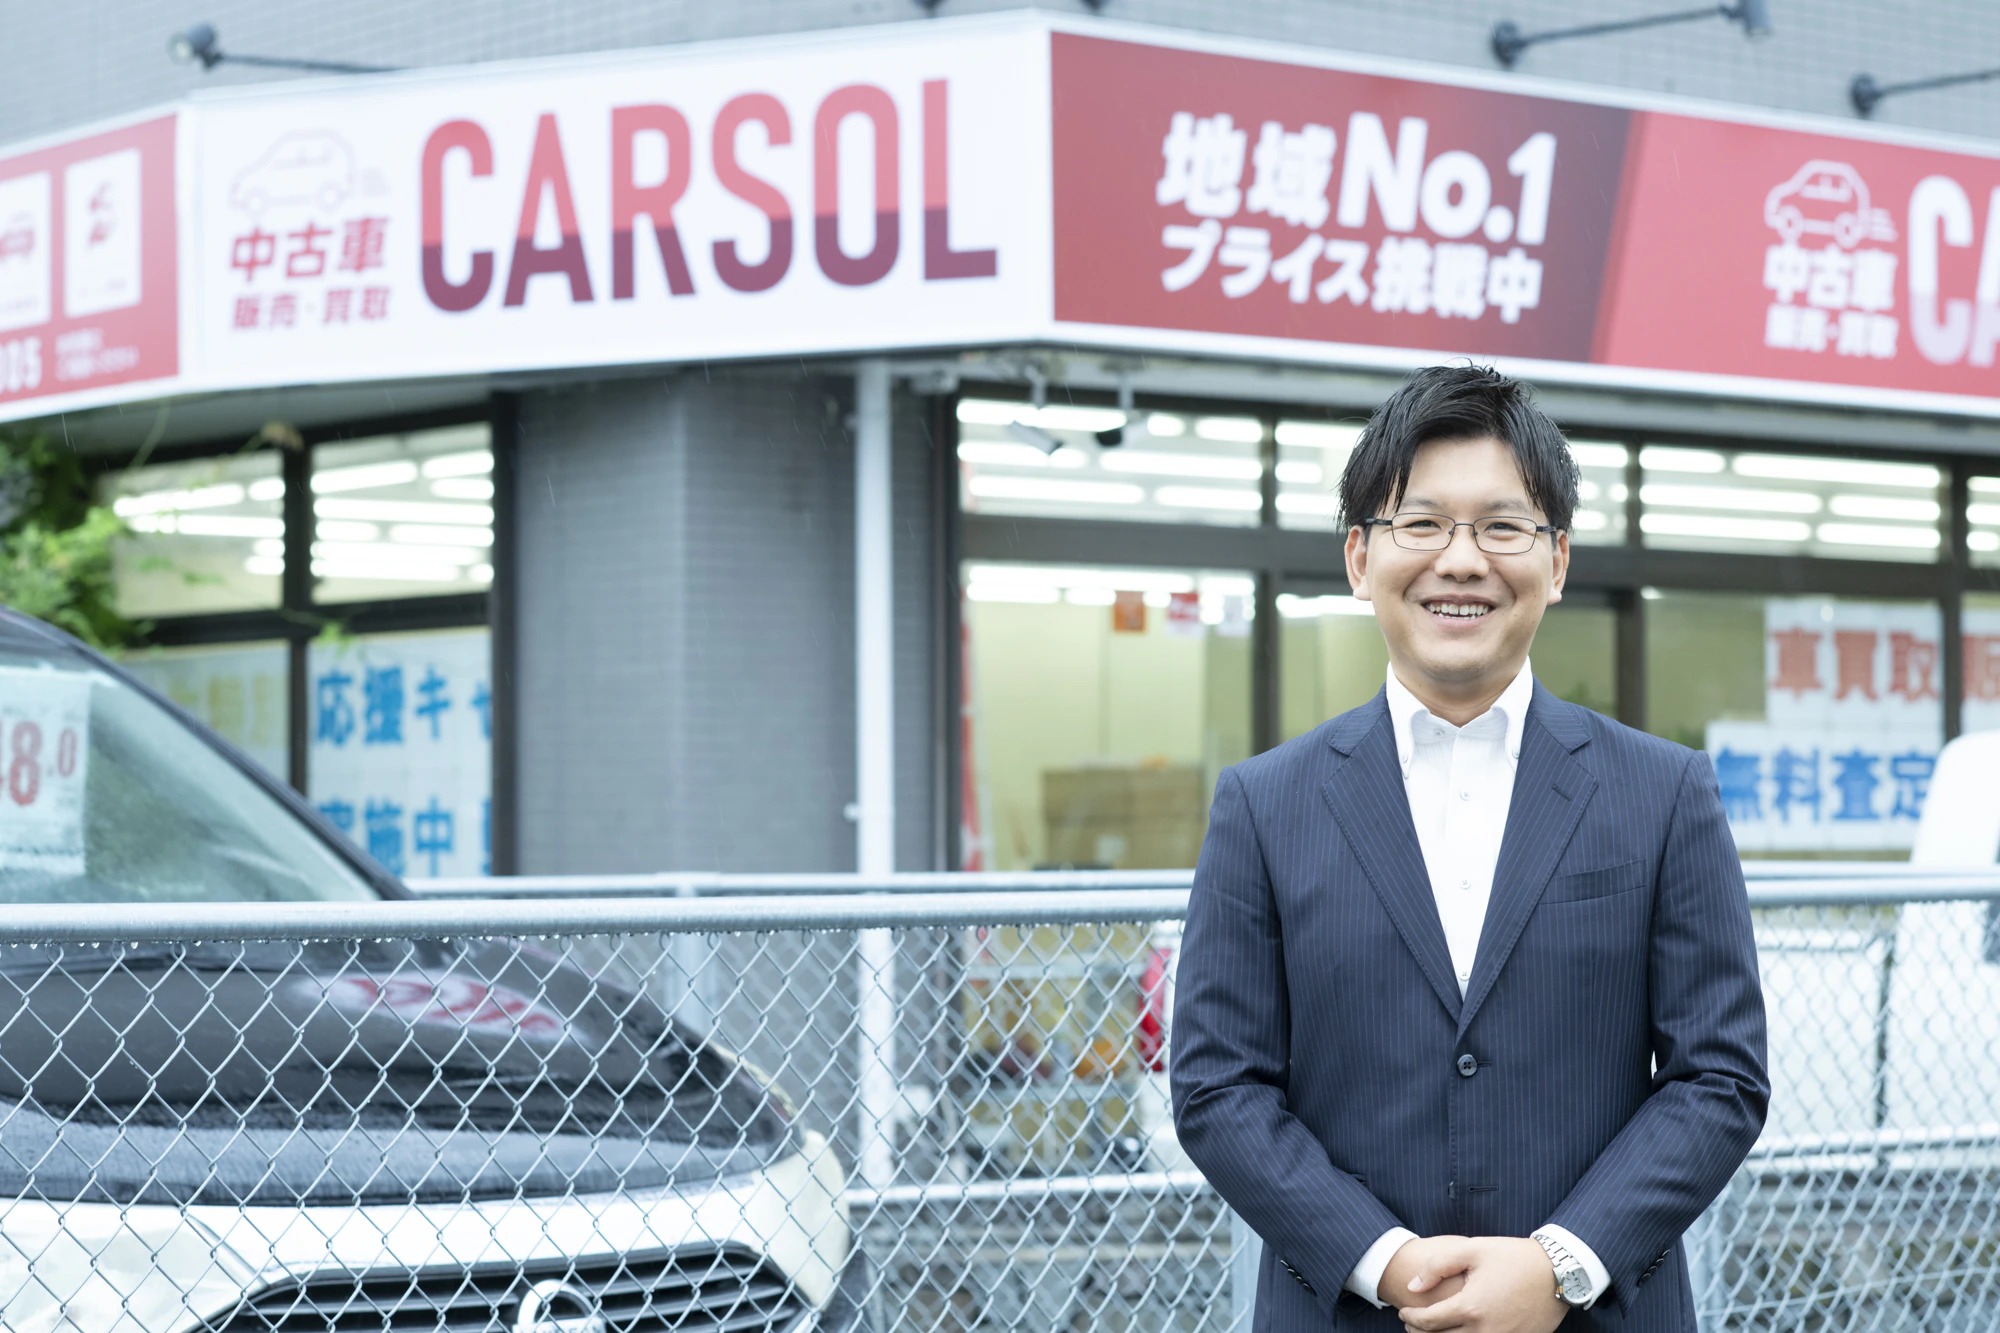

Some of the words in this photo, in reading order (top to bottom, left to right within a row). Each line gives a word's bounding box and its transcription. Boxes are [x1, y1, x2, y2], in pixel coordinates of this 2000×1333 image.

[421, 79, 998, 312] CARSOL
[231, 217, 389, 282] 中古車
[1161, 218, 1544, 324] プライス挑戦中
[0, 721, 77, 806] 8.0
